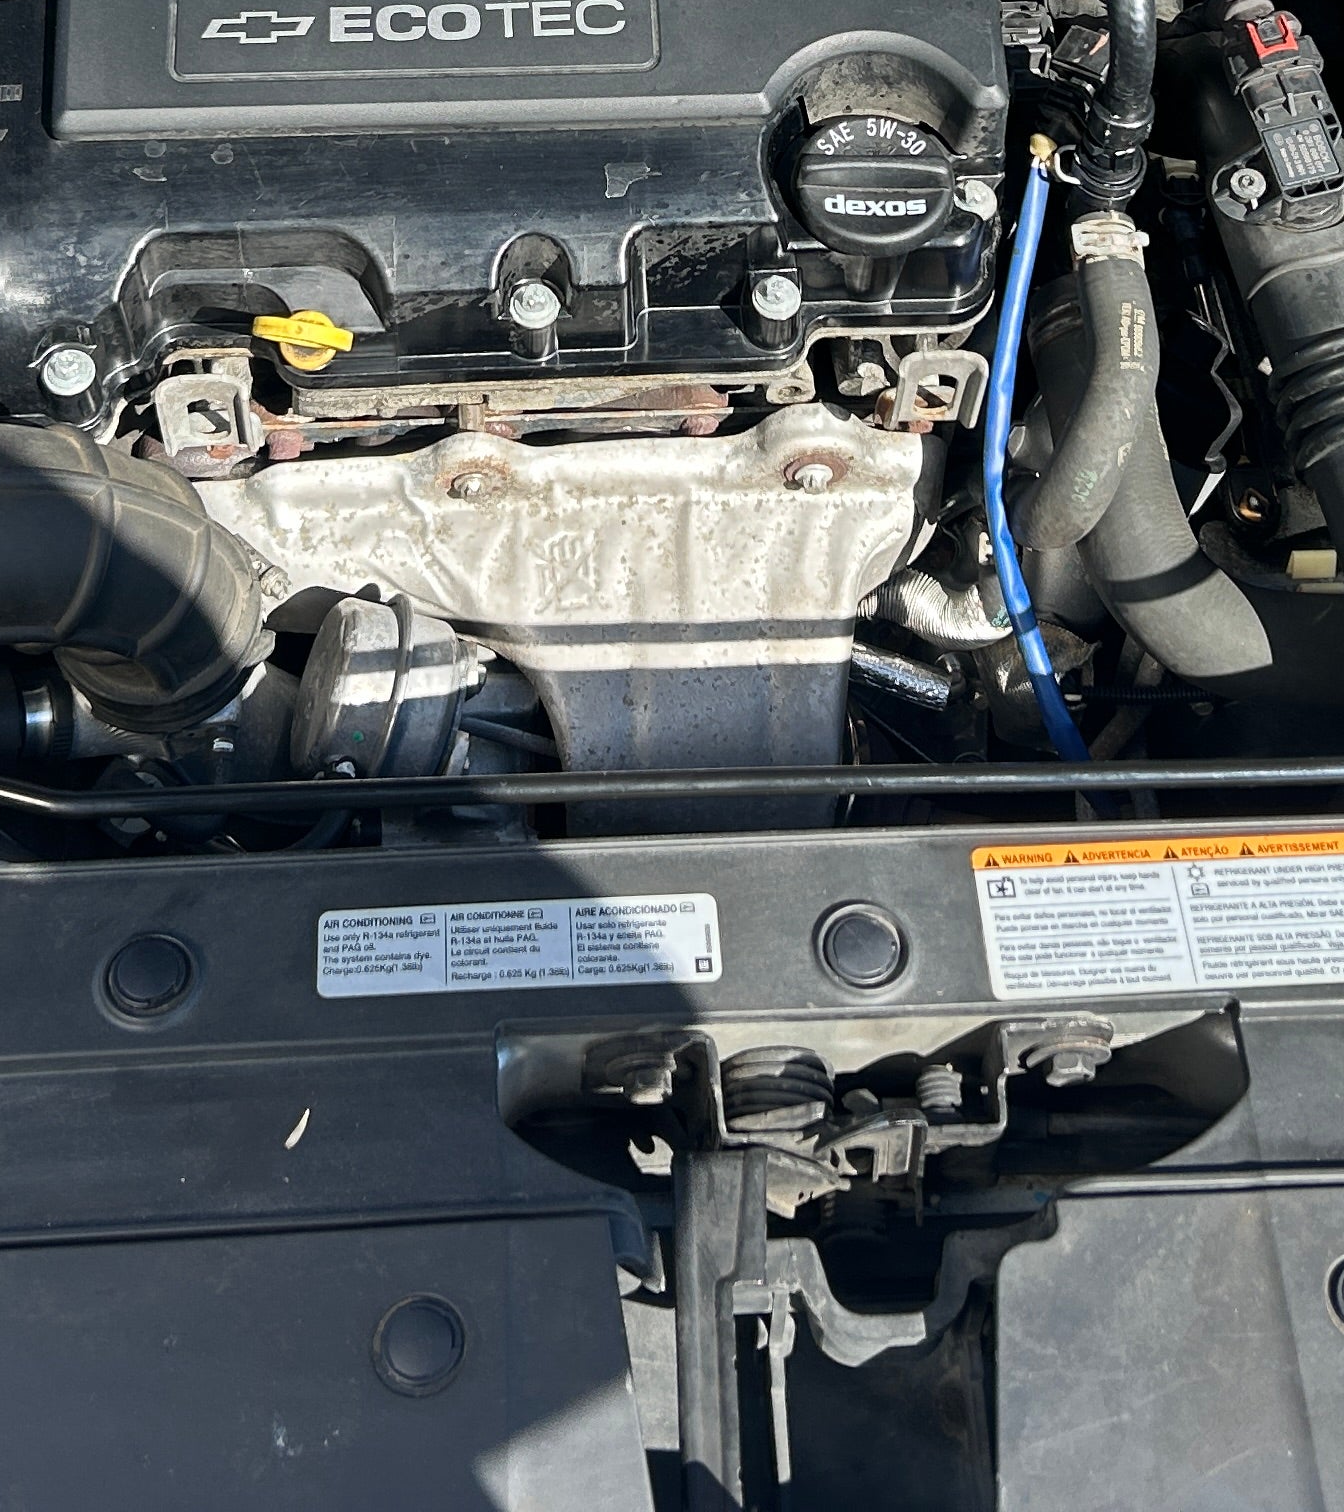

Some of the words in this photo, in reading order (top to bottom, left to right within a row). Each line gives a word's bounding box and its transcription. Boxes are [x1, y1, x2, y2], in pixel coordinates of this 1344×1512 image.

[816, 121, 855, 156] SAE
[866, 117, 927, 156] 5W-30
[824, 194, 927, 217] dexos
[1181, 844, 1229, 858] ATENÇÃO
[1257, 841, 1339, 854] AVERTISSEMENT
[1001, 853, 1053, 864] WARNING
[1082, 849, 1151, 861] ADVERTENCIA
[1214, 866, 1271, 876] REFRIGERANT
[1273, 865, 1303, 874] UNDER
[575, 907, 597, 917] AIRE
[599, 903, 678, 917] ACONDICIONADO
[323, 919, 340, 930] AIR
[342, 915, 414, 929] CONDITIONING
[450, 912, 465, 922] AIR
[482, 923, 533, 934] uniquement
[575, 921, 596, 930] Usar
[617, 919, 667, 930] refrigerante
[323, 933, 340, 942] Use
[342, 932, 361, 943] only
[362, 930, 394, 941] R-134a
[396, 928, 441, 940] refrigerant
[450, 934, 482, 946] R-134a
[576, 931, 608, 941] R-134a
[322, 944, 340, 954] and
[450, 948, 462, 957] Le
[463, 946, 490, 956] circuit
[529, 944, 541, 953] du
[323, 955, 339, 965] The
[341, 953, 373, 965] system
[374, 951, 412, 962] contains
[451, 971, 492, 982] Recharge
[499, 968, 523, 979] 0.625
[524, 967, 537, 979] Kg
[577, 964, 607, 976] Carga:
